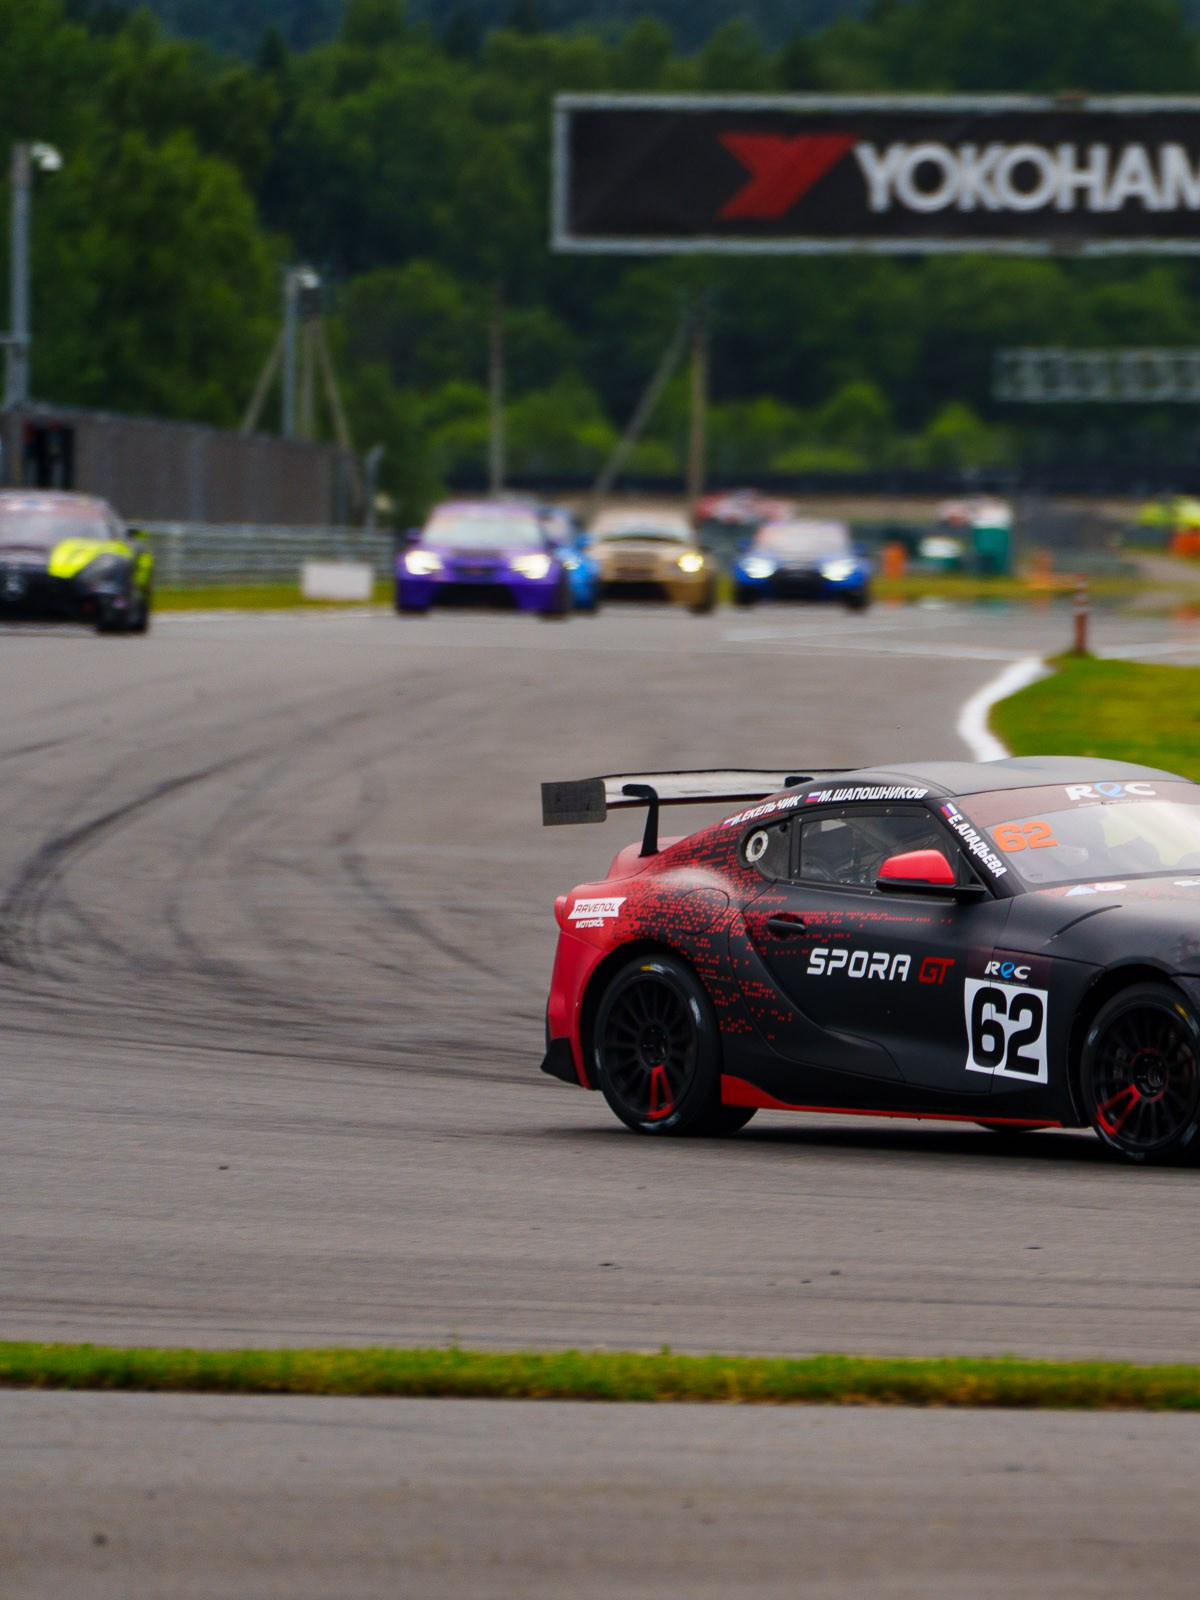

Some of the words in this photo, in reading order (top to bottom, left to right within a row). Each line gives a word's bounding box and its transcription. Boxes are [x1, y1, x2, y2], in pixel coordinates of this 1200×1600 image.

[817, 785, 929, 803] М.ШАПОШНИКОВ
[947, 813, 1008, 879] Е.АЛАДЬЕВА
[992, 820, 1058, 853] 62
[575, 902, 616, 914] RAVENOL
[807, 947, 911, 982] SPORA
[918, 956, 955, 985] GT
[971, 986, 1043, 1076] 62
